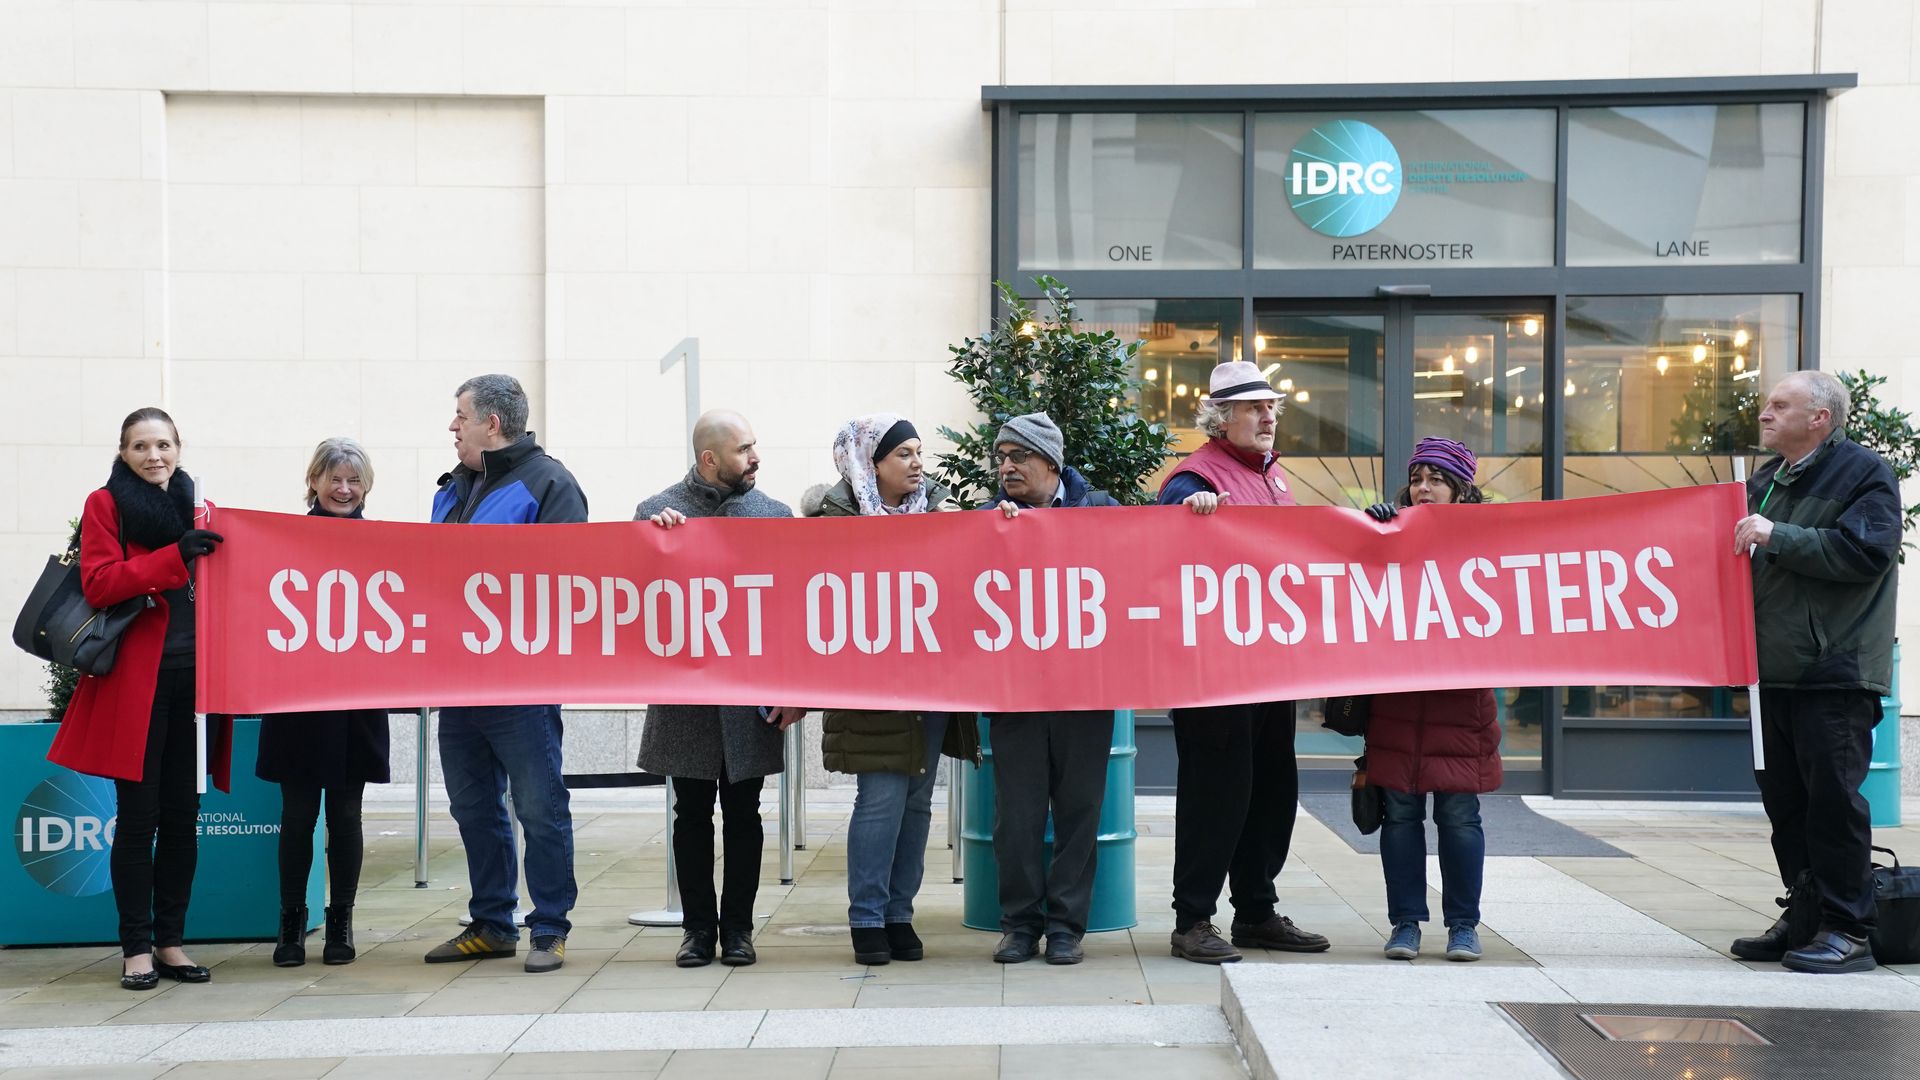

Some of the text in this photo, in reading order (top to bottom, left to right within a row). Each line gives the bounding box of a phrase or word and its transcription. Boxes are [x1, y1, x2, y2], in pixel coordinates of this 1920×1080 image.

[1292, 161, 1395, 196] IDRC
[1108, 240, 1710, 262] ONE PATERNOSTER LANE
[267, 568, 426, 654] SOS:
[462, 572, 774, 657] SUPPORT
[805, 570, 942, 656] OUR
[973, 566, 1107, 652] SUB
[1180, 545, 1679, 647] POSTMASTERS
[196, 812, 247, 823] ATIONAL
